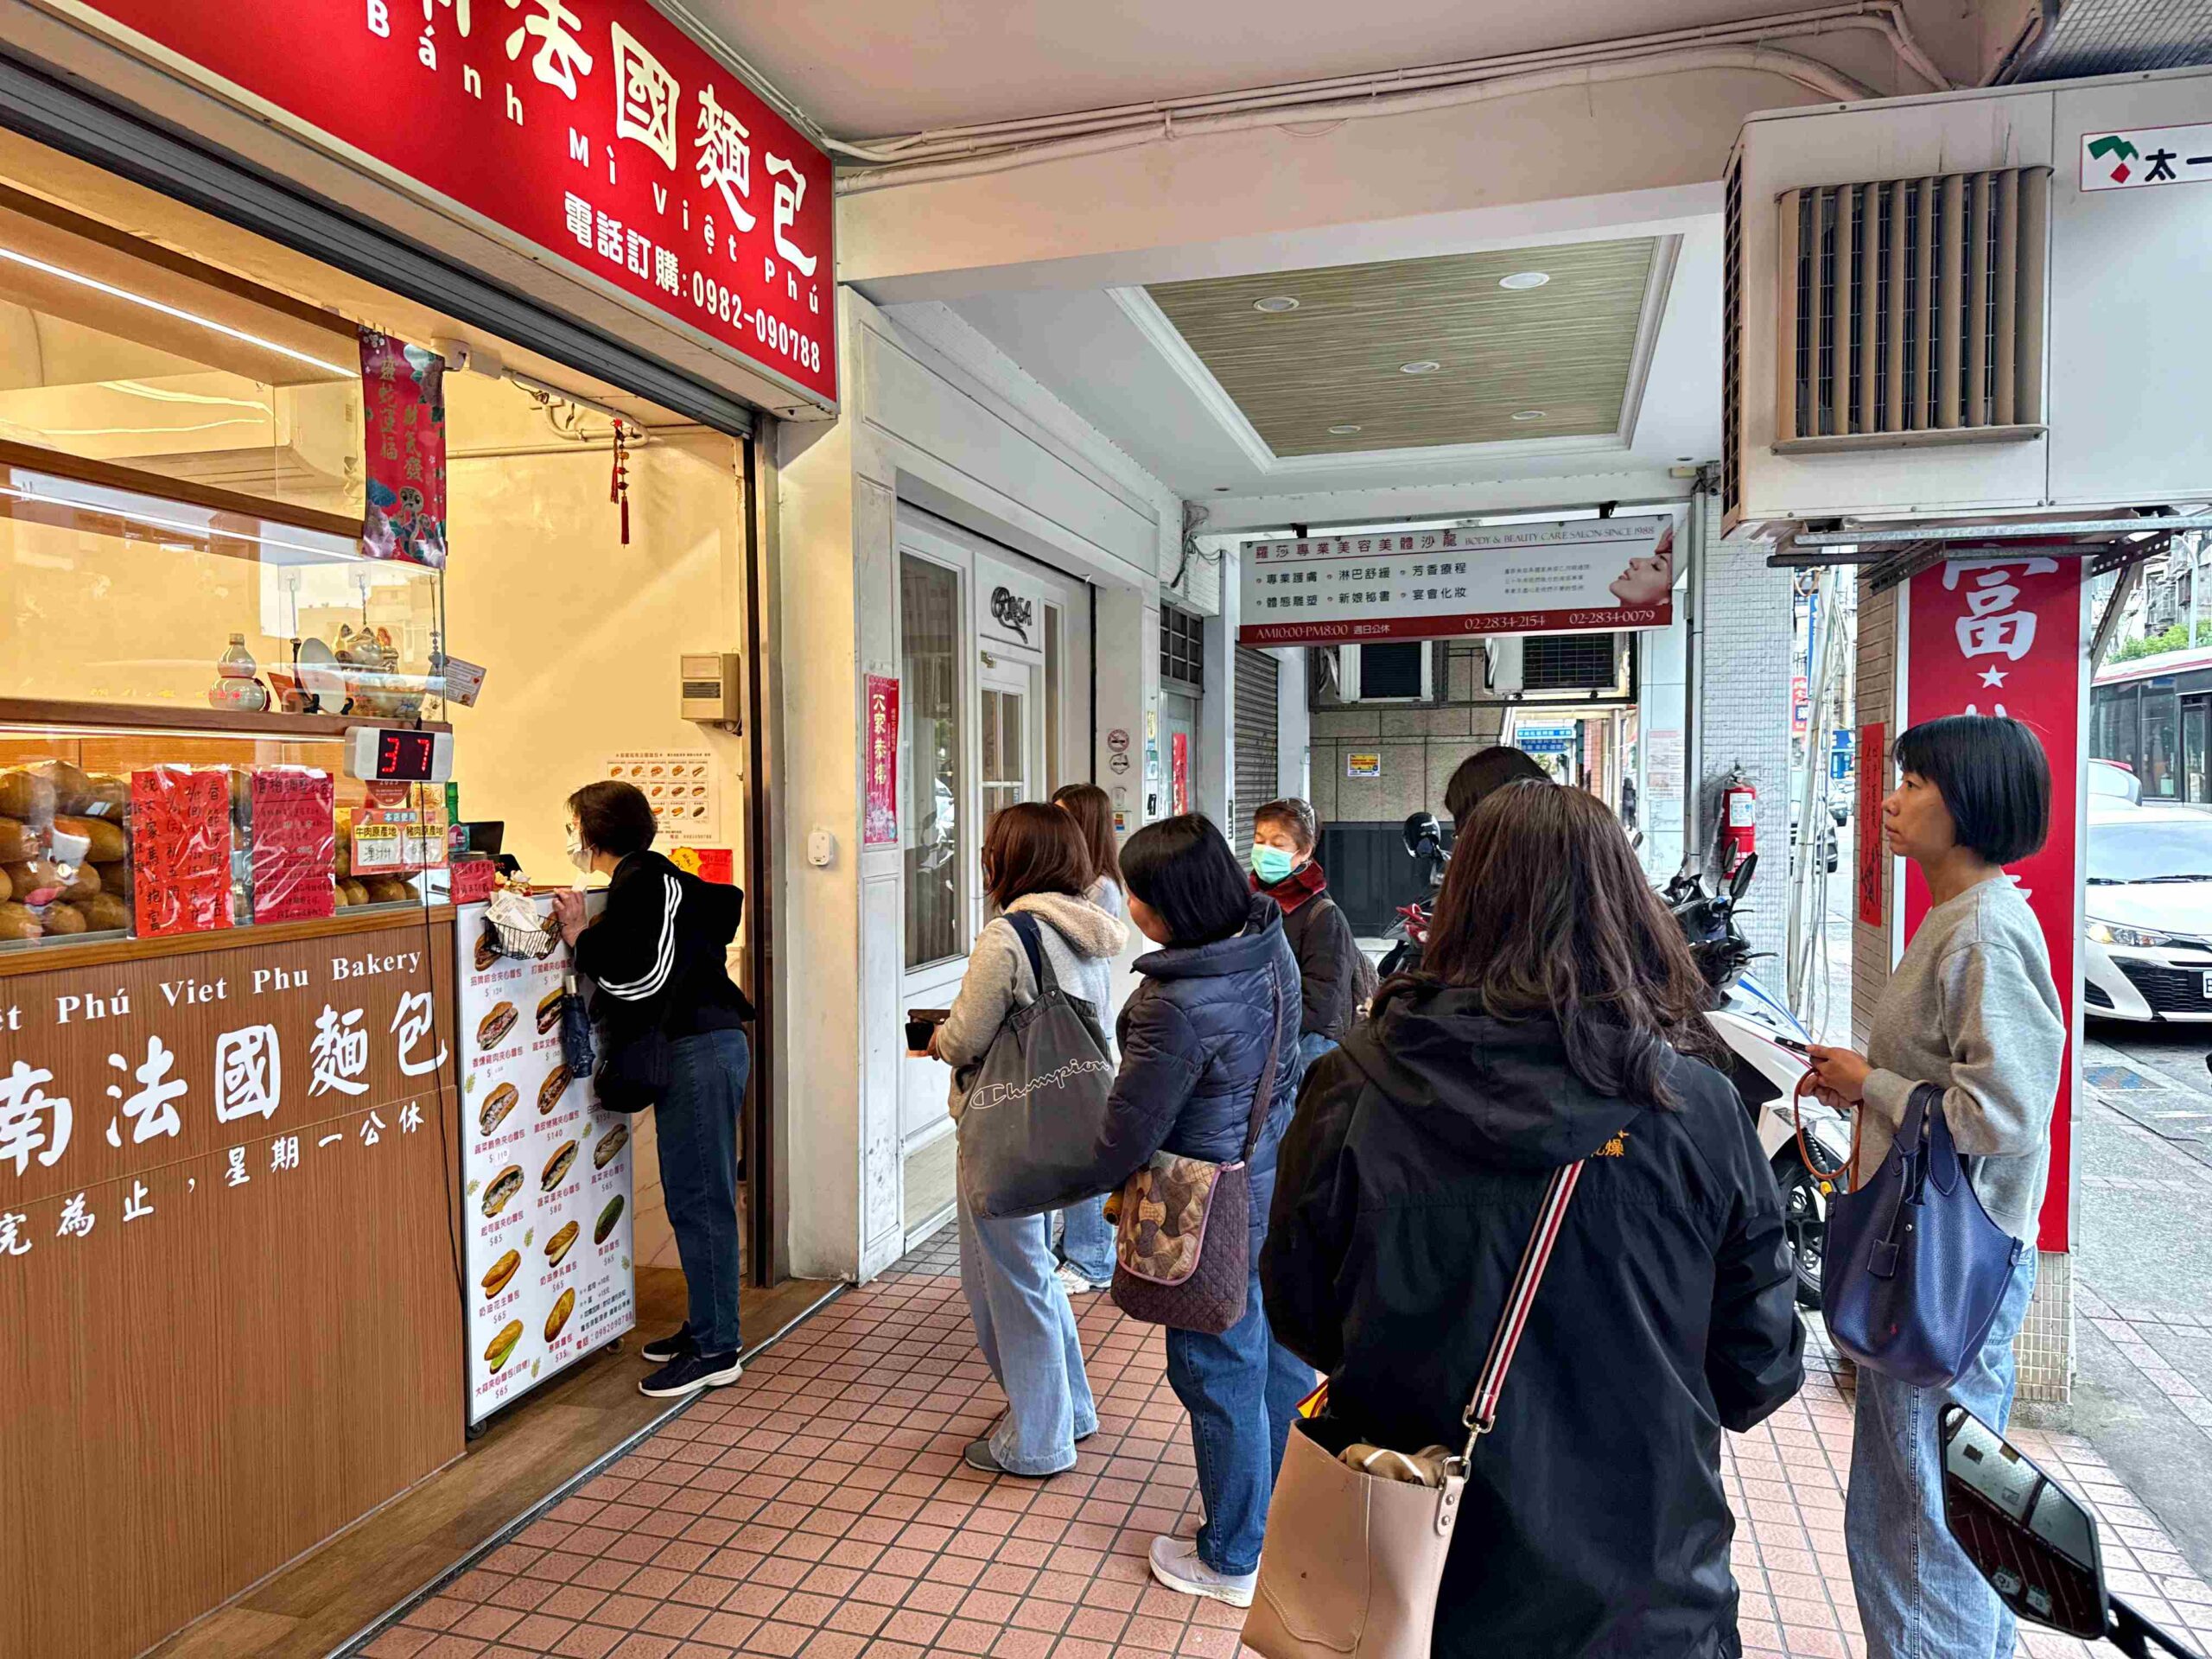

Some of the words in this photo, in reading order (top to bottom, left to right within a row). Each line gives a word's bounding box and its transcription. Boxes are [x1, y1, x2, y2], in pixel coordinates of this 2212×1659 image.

[569, 127, 617, 185] Mì
[653, 181, 737, 263] Việt
[765, 257, 820, 315] Phú
[1465, 537, 1490, 546] BODY
[1492, 535, 1501, 543] &
[1503, 533, 1538, 543] BEAUTY
[1541, 531, 1568, 542] CARE
[1266, 571, 1318, 584] 專業護膚
[1338, 567, 1391, 582] 淋巴舒緩
[1412, 563, 1466, 577] 芳香療程
[1266, 594, 1319, 608] 體態雕塑
[1338, 591, 1390, 604] 新娘秘書
[1412, 588, 1466, 601] 宴會化妝
[1569, 610, 1656, 625] 02-2834-0079
[1353, 625, 1390, 635] 週日公休
[384, 812, 417, 822] 本店使用
[355, 826, 397, 838] 牛肉原產地
[406, 825, 444, 837] 豬肉原產地
[55, 988, 130, 1025] Phú
[160, 976, 227, 1008] Viet
[252, 966, 308, 993] Phu
[331, 950, 422, 982] Bakery
[0, 990, 448, 1177] 南法國麵包
[969, 1058, 1109, 1109] Champion
[490, 1234, 503, 1247] $85
[552, 1281, 564, 1293] $65
[493, 1311, 506, 1324] $65
[556, 1349, 567, 1363] $35
[495, 1385, 508, 1399] $65
